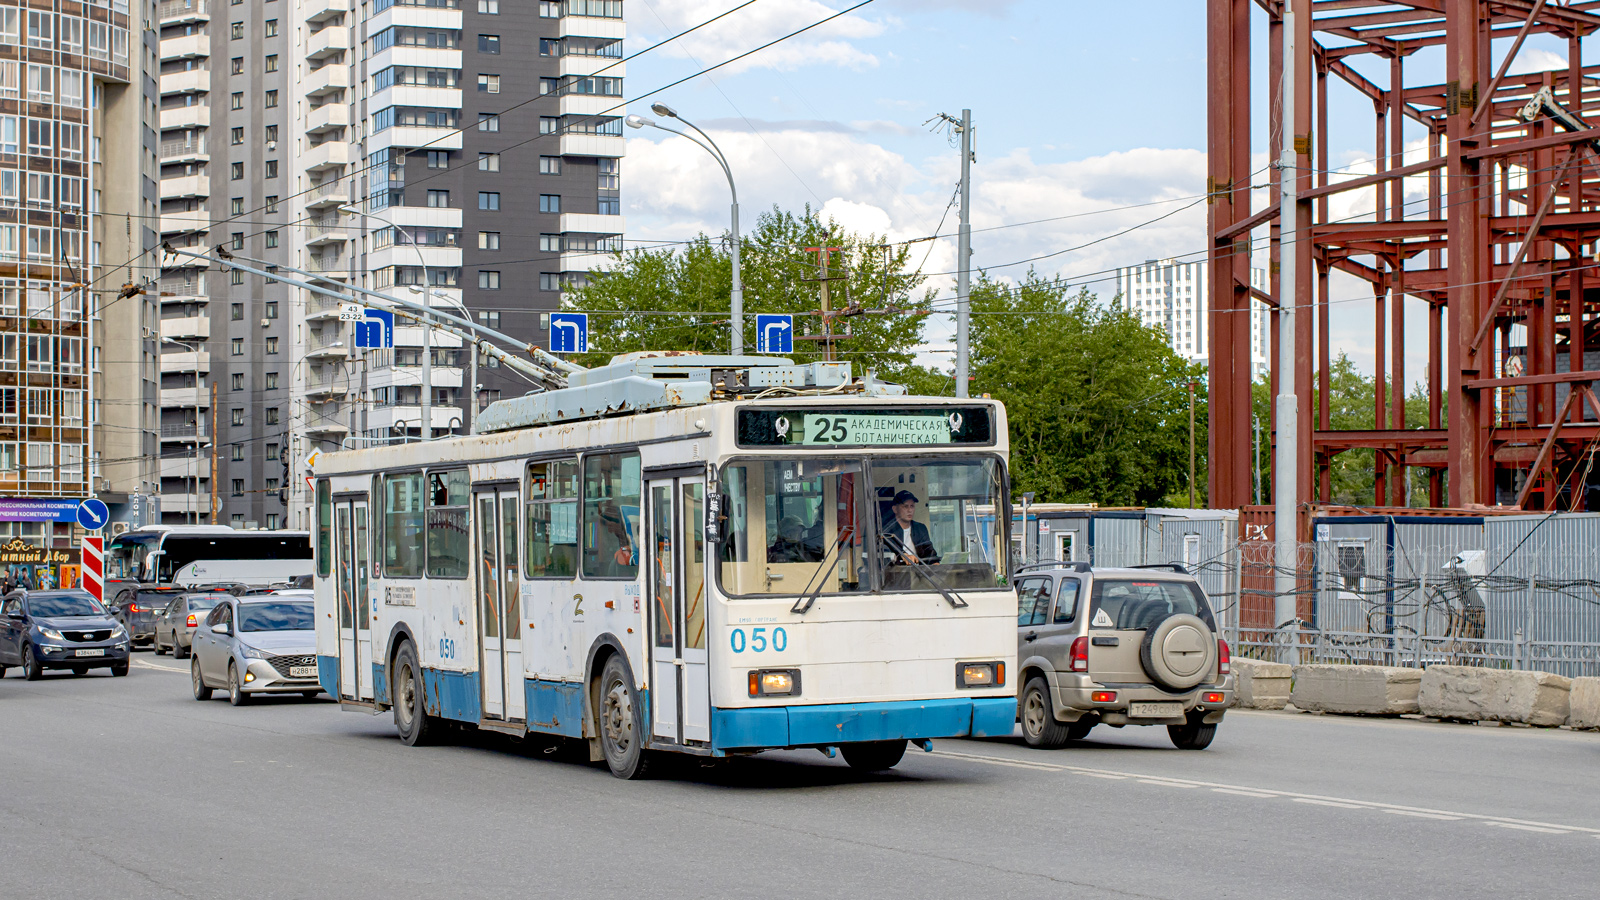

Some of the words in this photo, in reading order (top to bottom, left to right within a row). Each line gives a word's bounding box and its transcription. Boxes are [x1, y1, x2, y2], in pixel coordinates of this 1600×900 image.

[813, 417, 848, 442] 25
[851, 419, 943, 430] АКАДЕМИЧЕСКАЯ
[854, 432, 938, 443] БОТАНИЧЕСКАЯ
[440, 638, 455, 659] 050
[731, 627, 787, 653] 050
